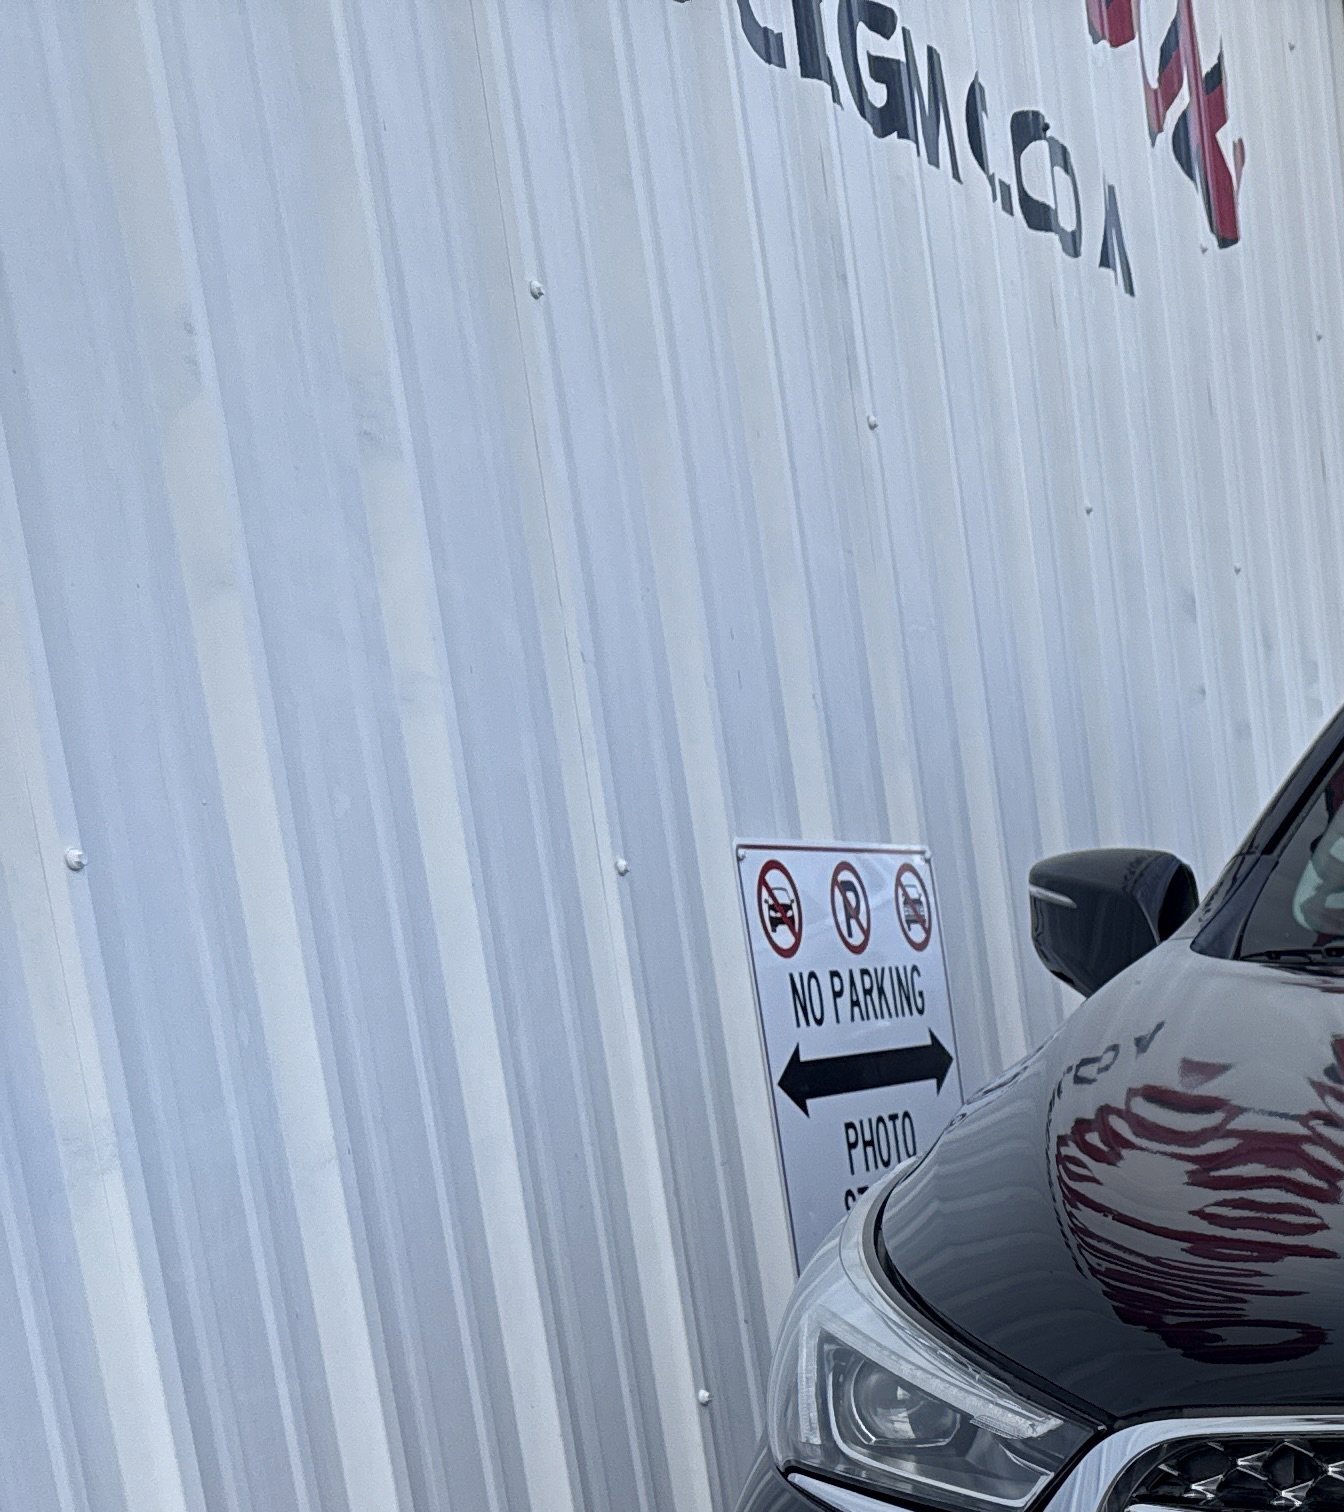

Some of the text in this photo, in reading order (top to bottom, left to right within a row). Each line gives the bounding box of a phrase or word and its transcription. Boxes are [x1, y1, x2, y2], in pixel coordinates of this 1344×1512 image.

[788, 964, 925, 1028] NO PARKING
[844, 1110, 917, 1176] PHOTO
